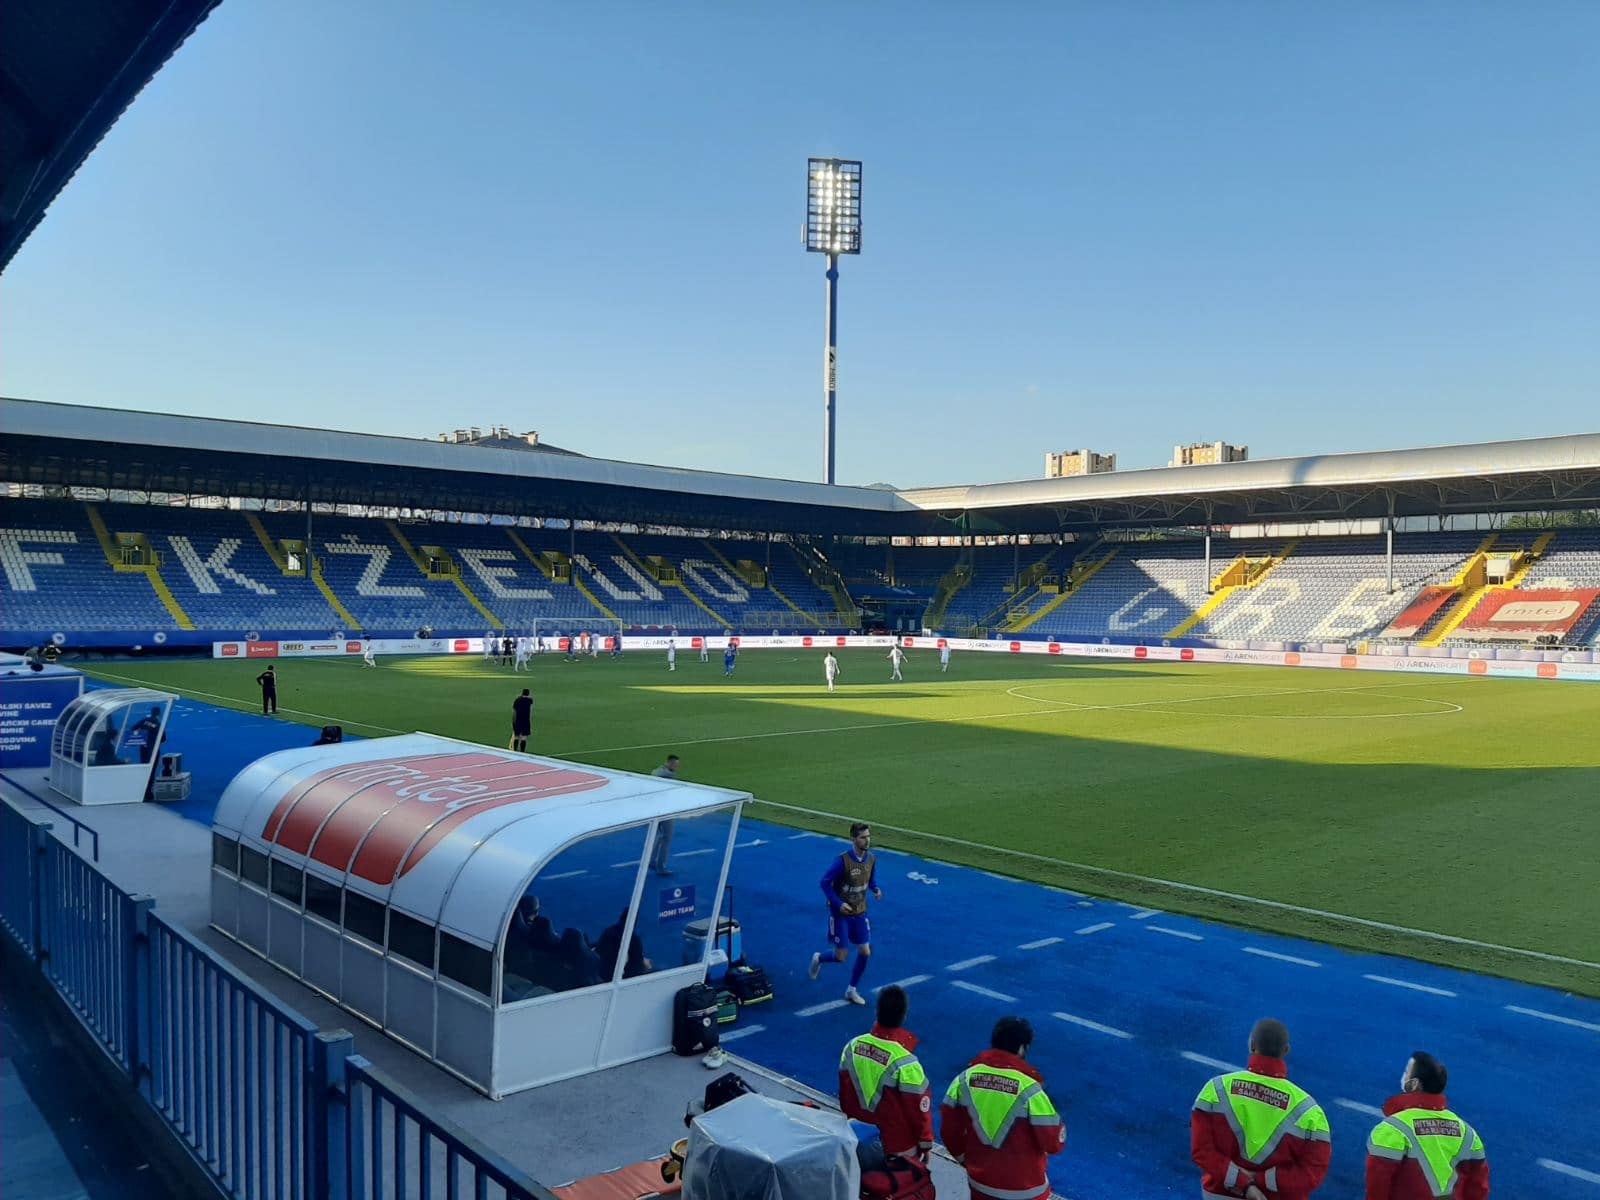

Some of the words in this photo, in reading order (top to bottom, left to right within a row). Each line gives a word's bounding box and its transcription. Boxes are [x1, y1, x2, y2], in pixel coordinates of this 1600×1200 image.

[24, 702, 53, 710] SAVEZ
[658, 909, 677, 918] HOME
[678, 905, 695, 914] TEAM
[1232, 1079, 1257, 1091] HITNA
[1238, 1087, 1281, 1107] SARAJEVO
